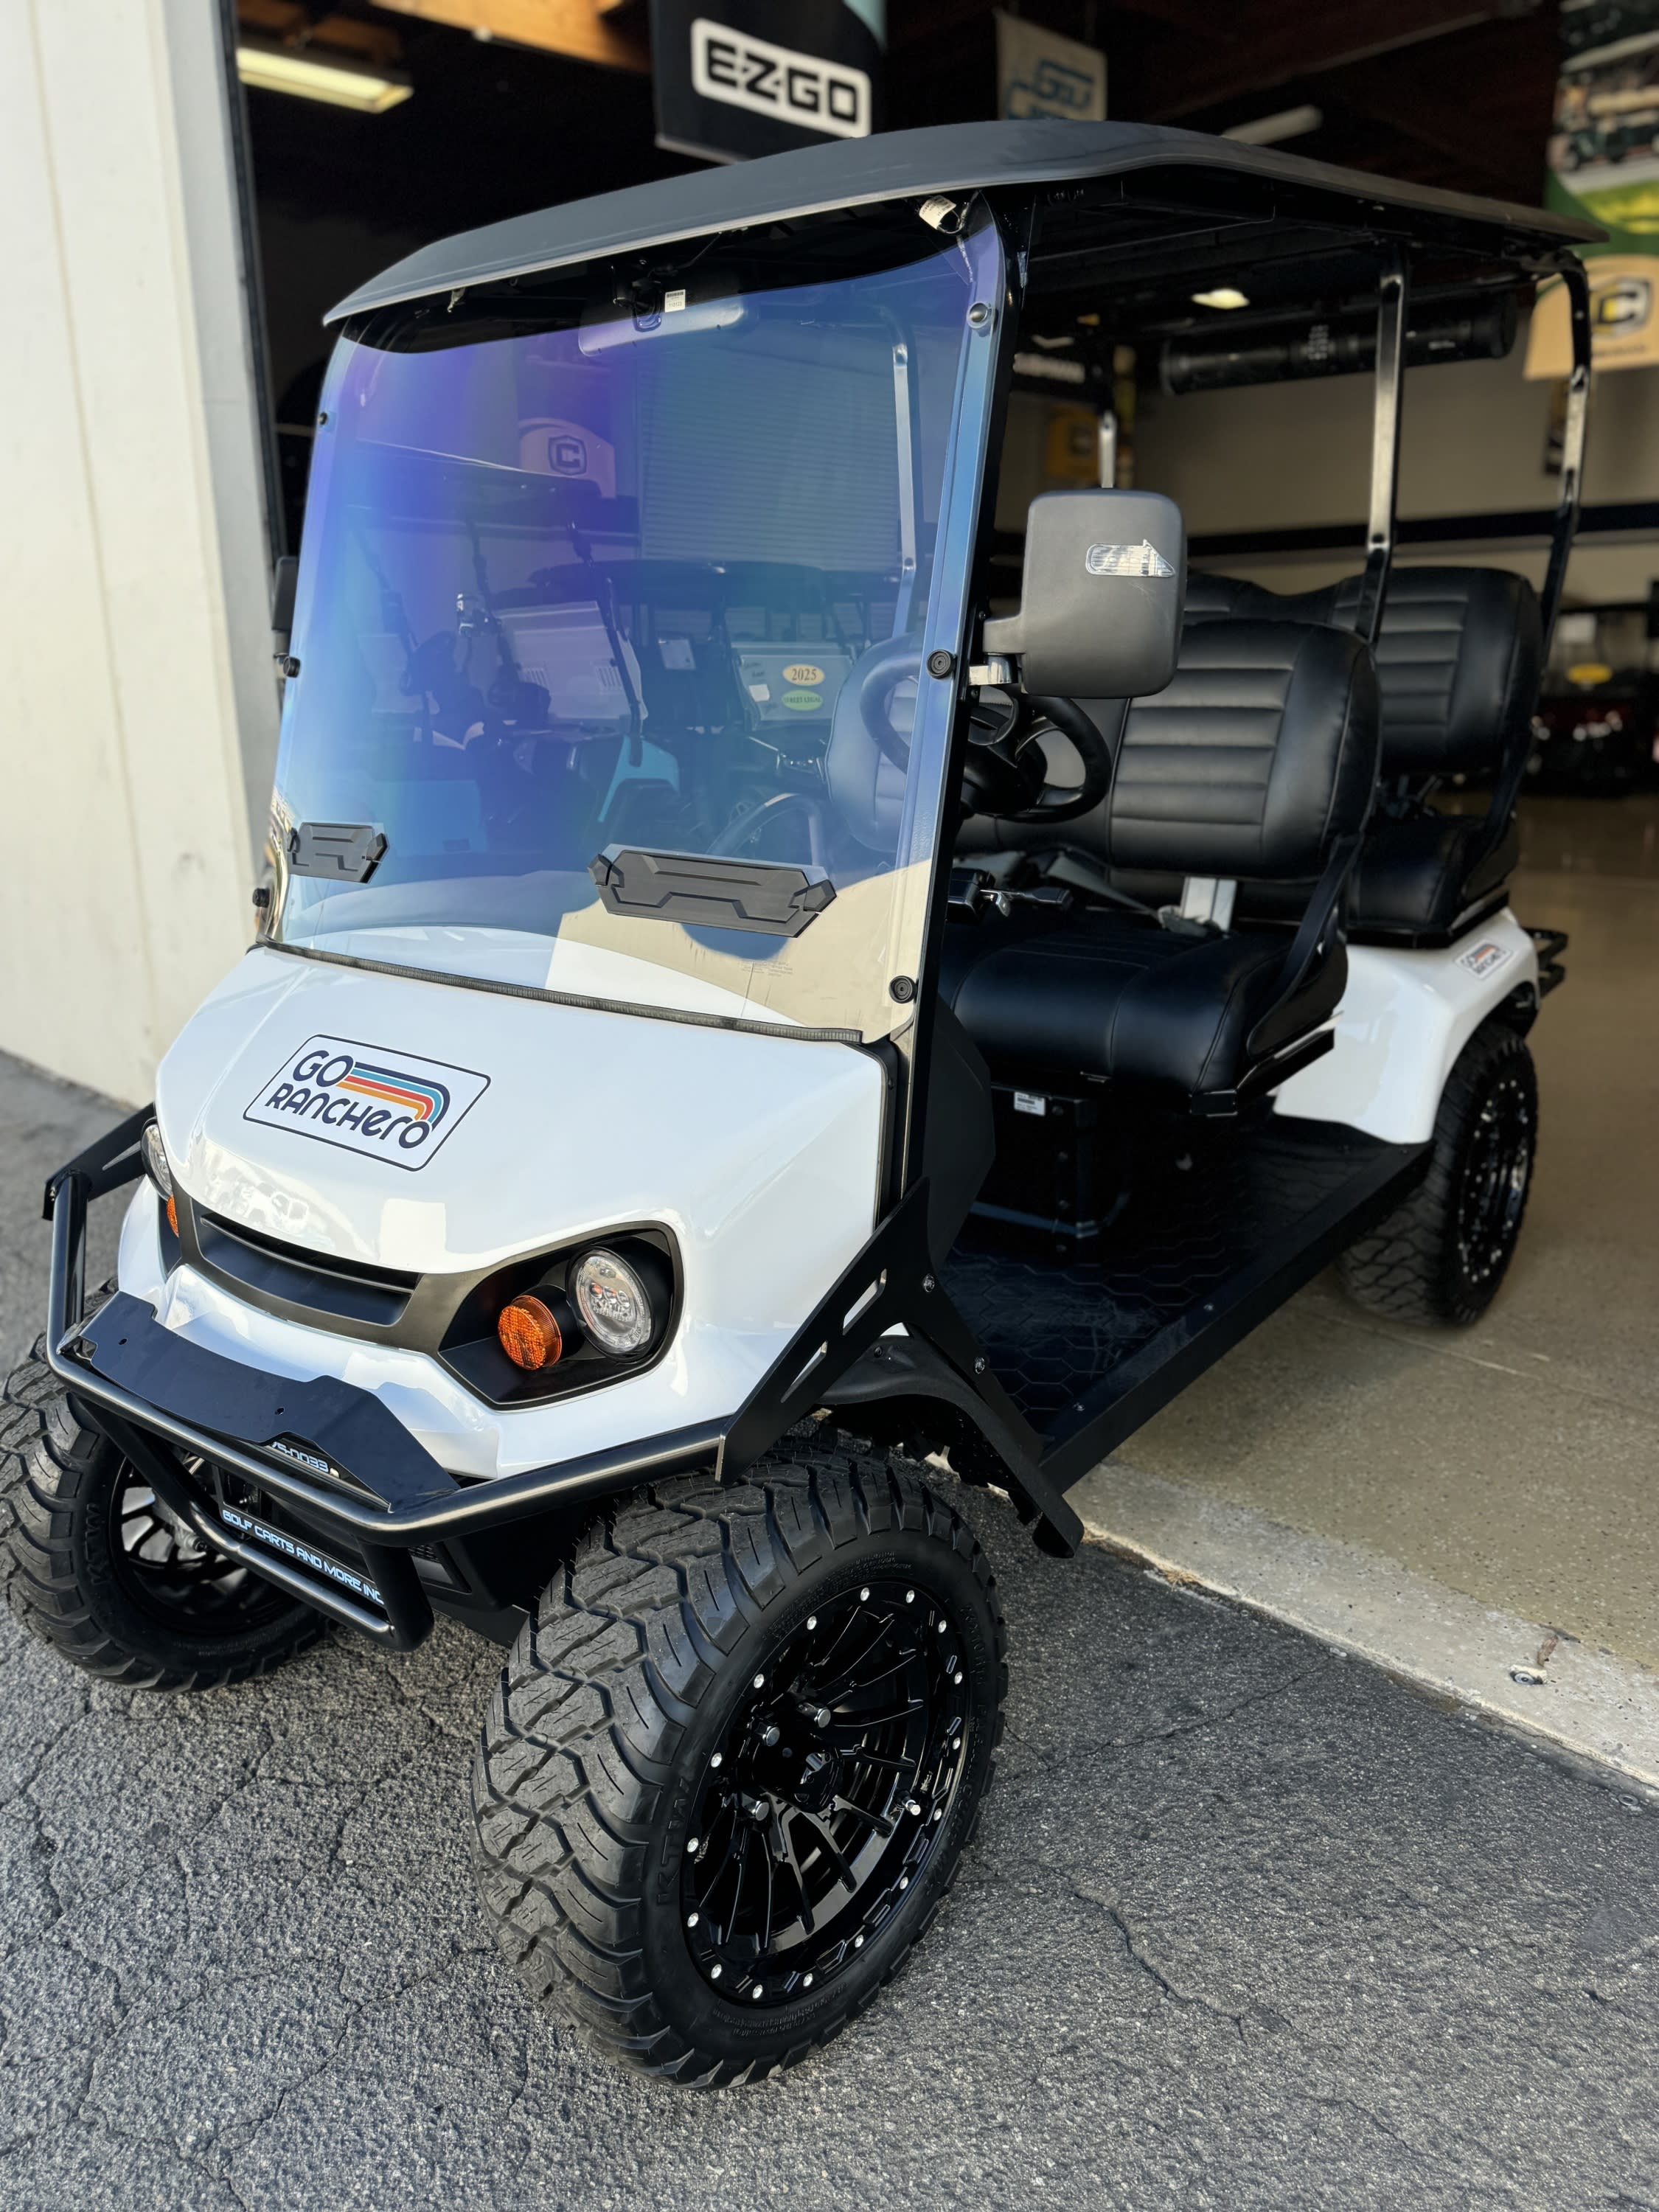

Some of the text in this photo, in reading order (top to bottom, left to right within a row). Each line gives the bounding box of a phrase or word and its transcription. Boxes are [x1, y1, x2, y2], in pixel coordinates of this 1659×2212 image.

[791, 668, 817, 681] 2025
[293, 1050, 354, 1088] GO
[223, 1509, 253, 1531] GOLF
[254, 1525, 294, 1554] CARTS
[296, 1547, 322, 1570] AND
[324, 1560, 362, 1592] MORE
